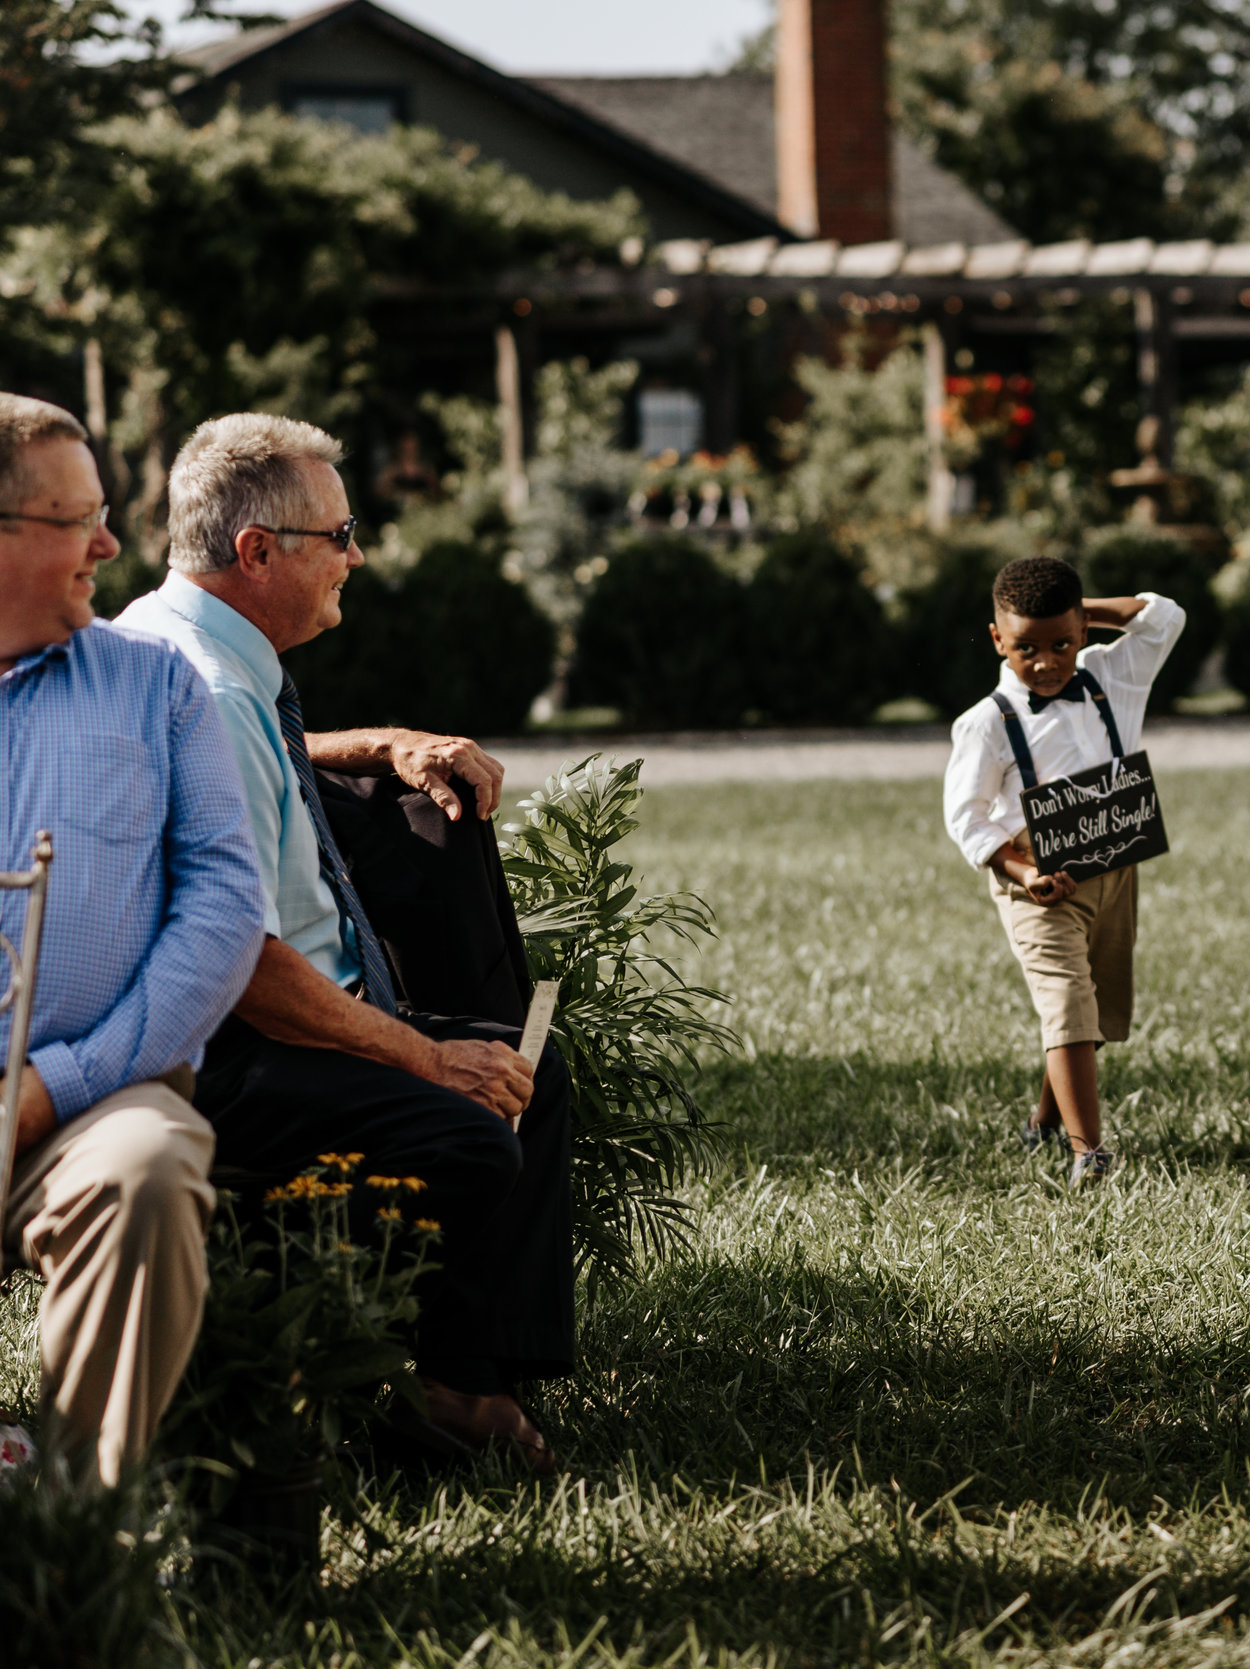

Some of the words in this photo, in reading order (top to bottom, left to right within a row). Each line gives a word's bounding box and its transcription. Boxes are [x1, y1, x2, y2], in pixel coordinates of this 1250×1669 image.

[1030, 792, 1064, 820] Don't
[1035, 829, 1077, 858] We're
[1078, 809, 1109, 844] Still
[1111, 792, 1156, 832] Single!
